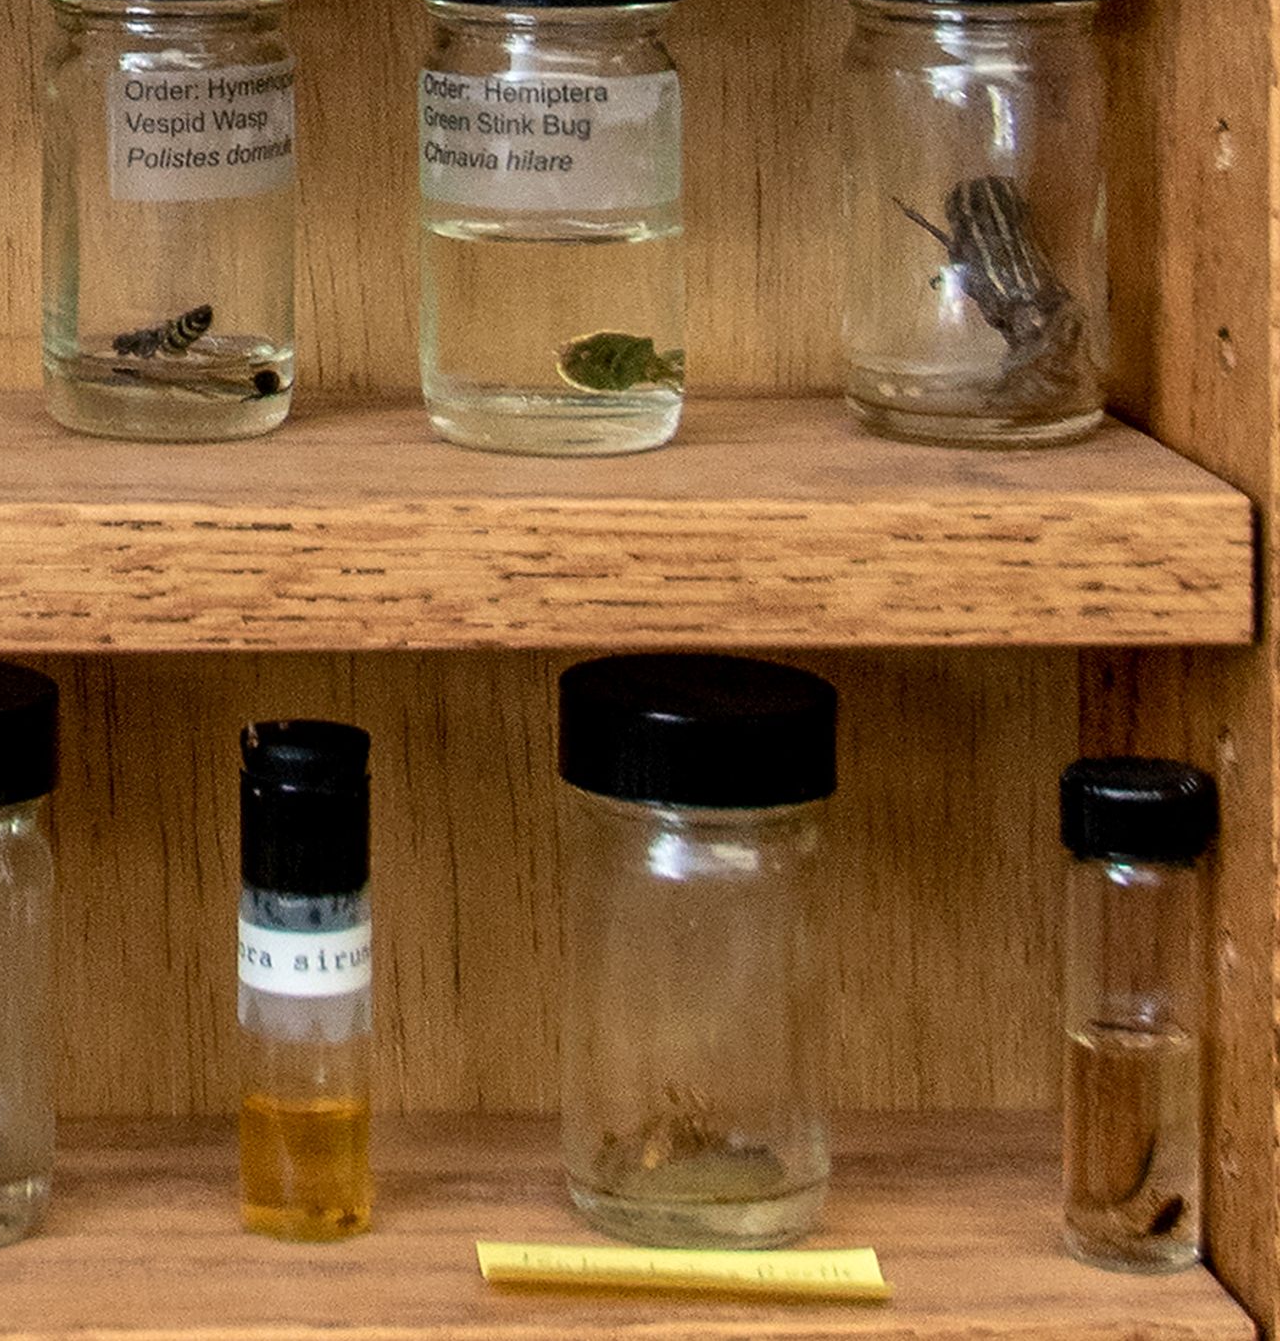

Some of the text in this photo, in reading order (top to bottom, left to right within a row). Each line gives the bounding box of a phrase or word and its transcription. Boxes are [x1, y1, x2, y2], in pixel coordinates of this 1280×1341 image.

[125, 79, 200, 102] Order:
[423, 72, 609, 109] Order: Hemiptera
[126, 110, 269, 138] Vespid Wasp
[423, 105, 592, 141] Green Stink Bug
[128, 146, 220, 169] Polistes
[424, 140, 574, 172] Chinavia hilare
